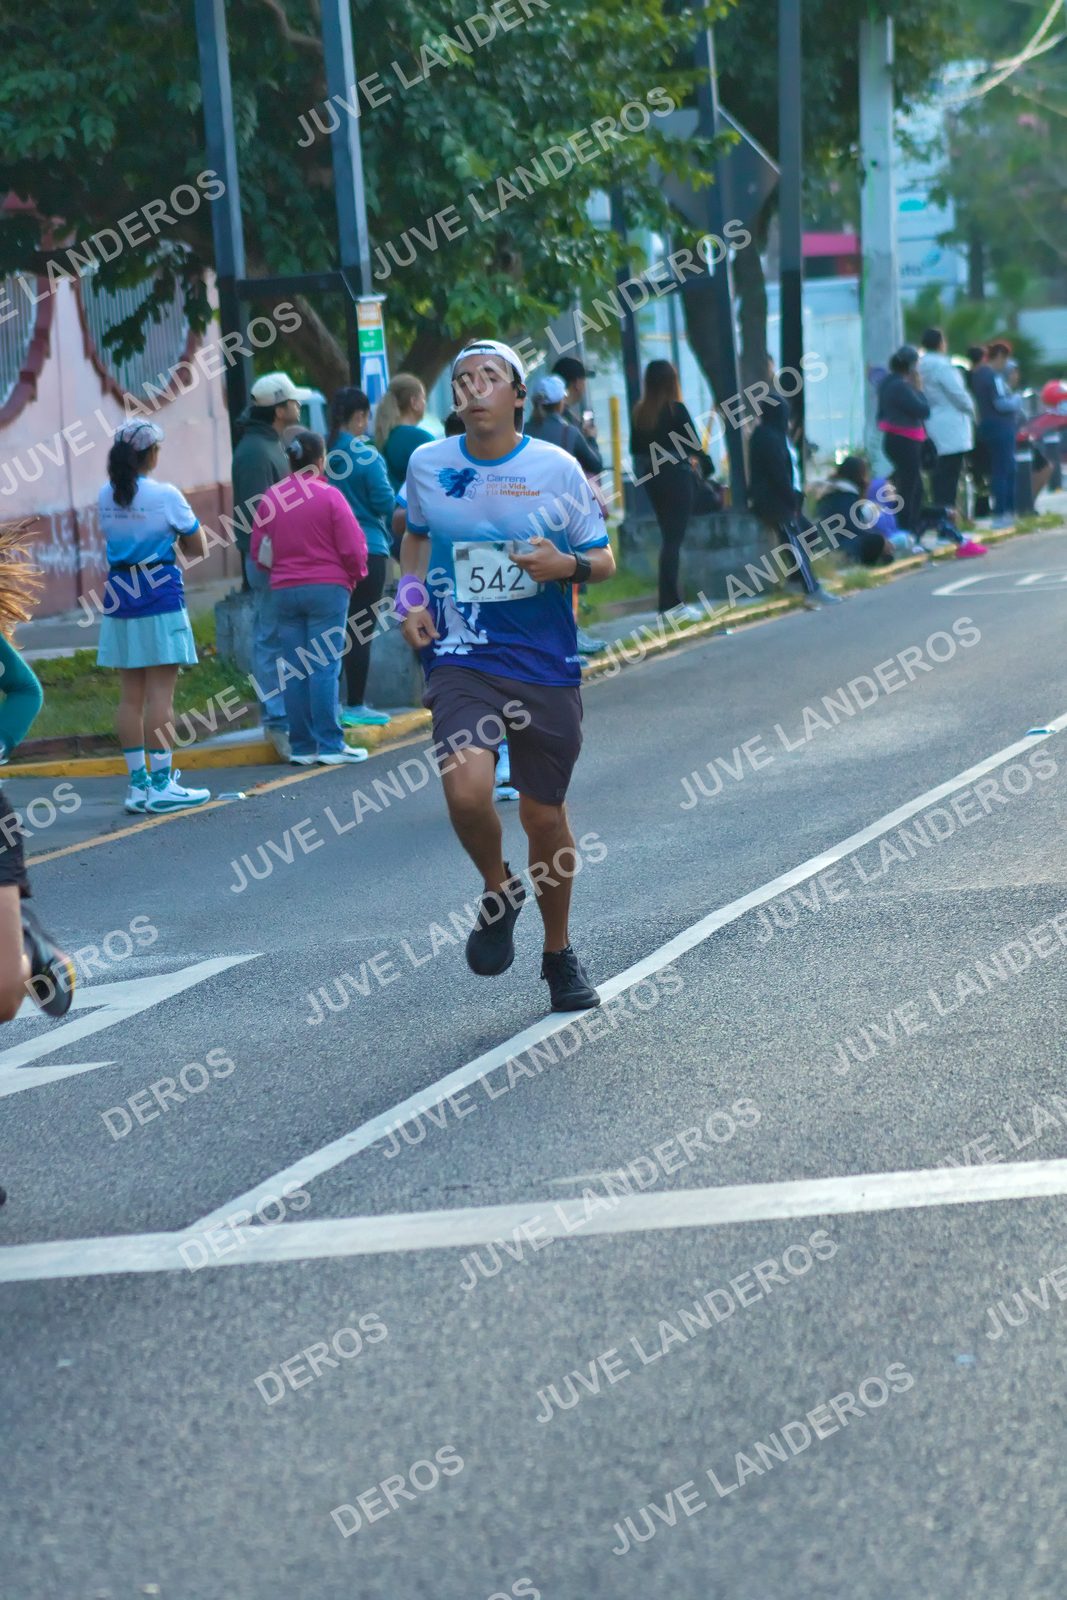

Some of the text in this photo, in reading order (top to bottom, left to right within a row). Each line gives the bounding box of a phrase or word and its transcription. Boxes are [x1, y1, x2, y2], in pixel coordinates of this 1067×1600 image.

[487, 473, 527, 483] Carrera
[500, 489, 541, 497] Integridad
[468, 564, 525, 593] 542
